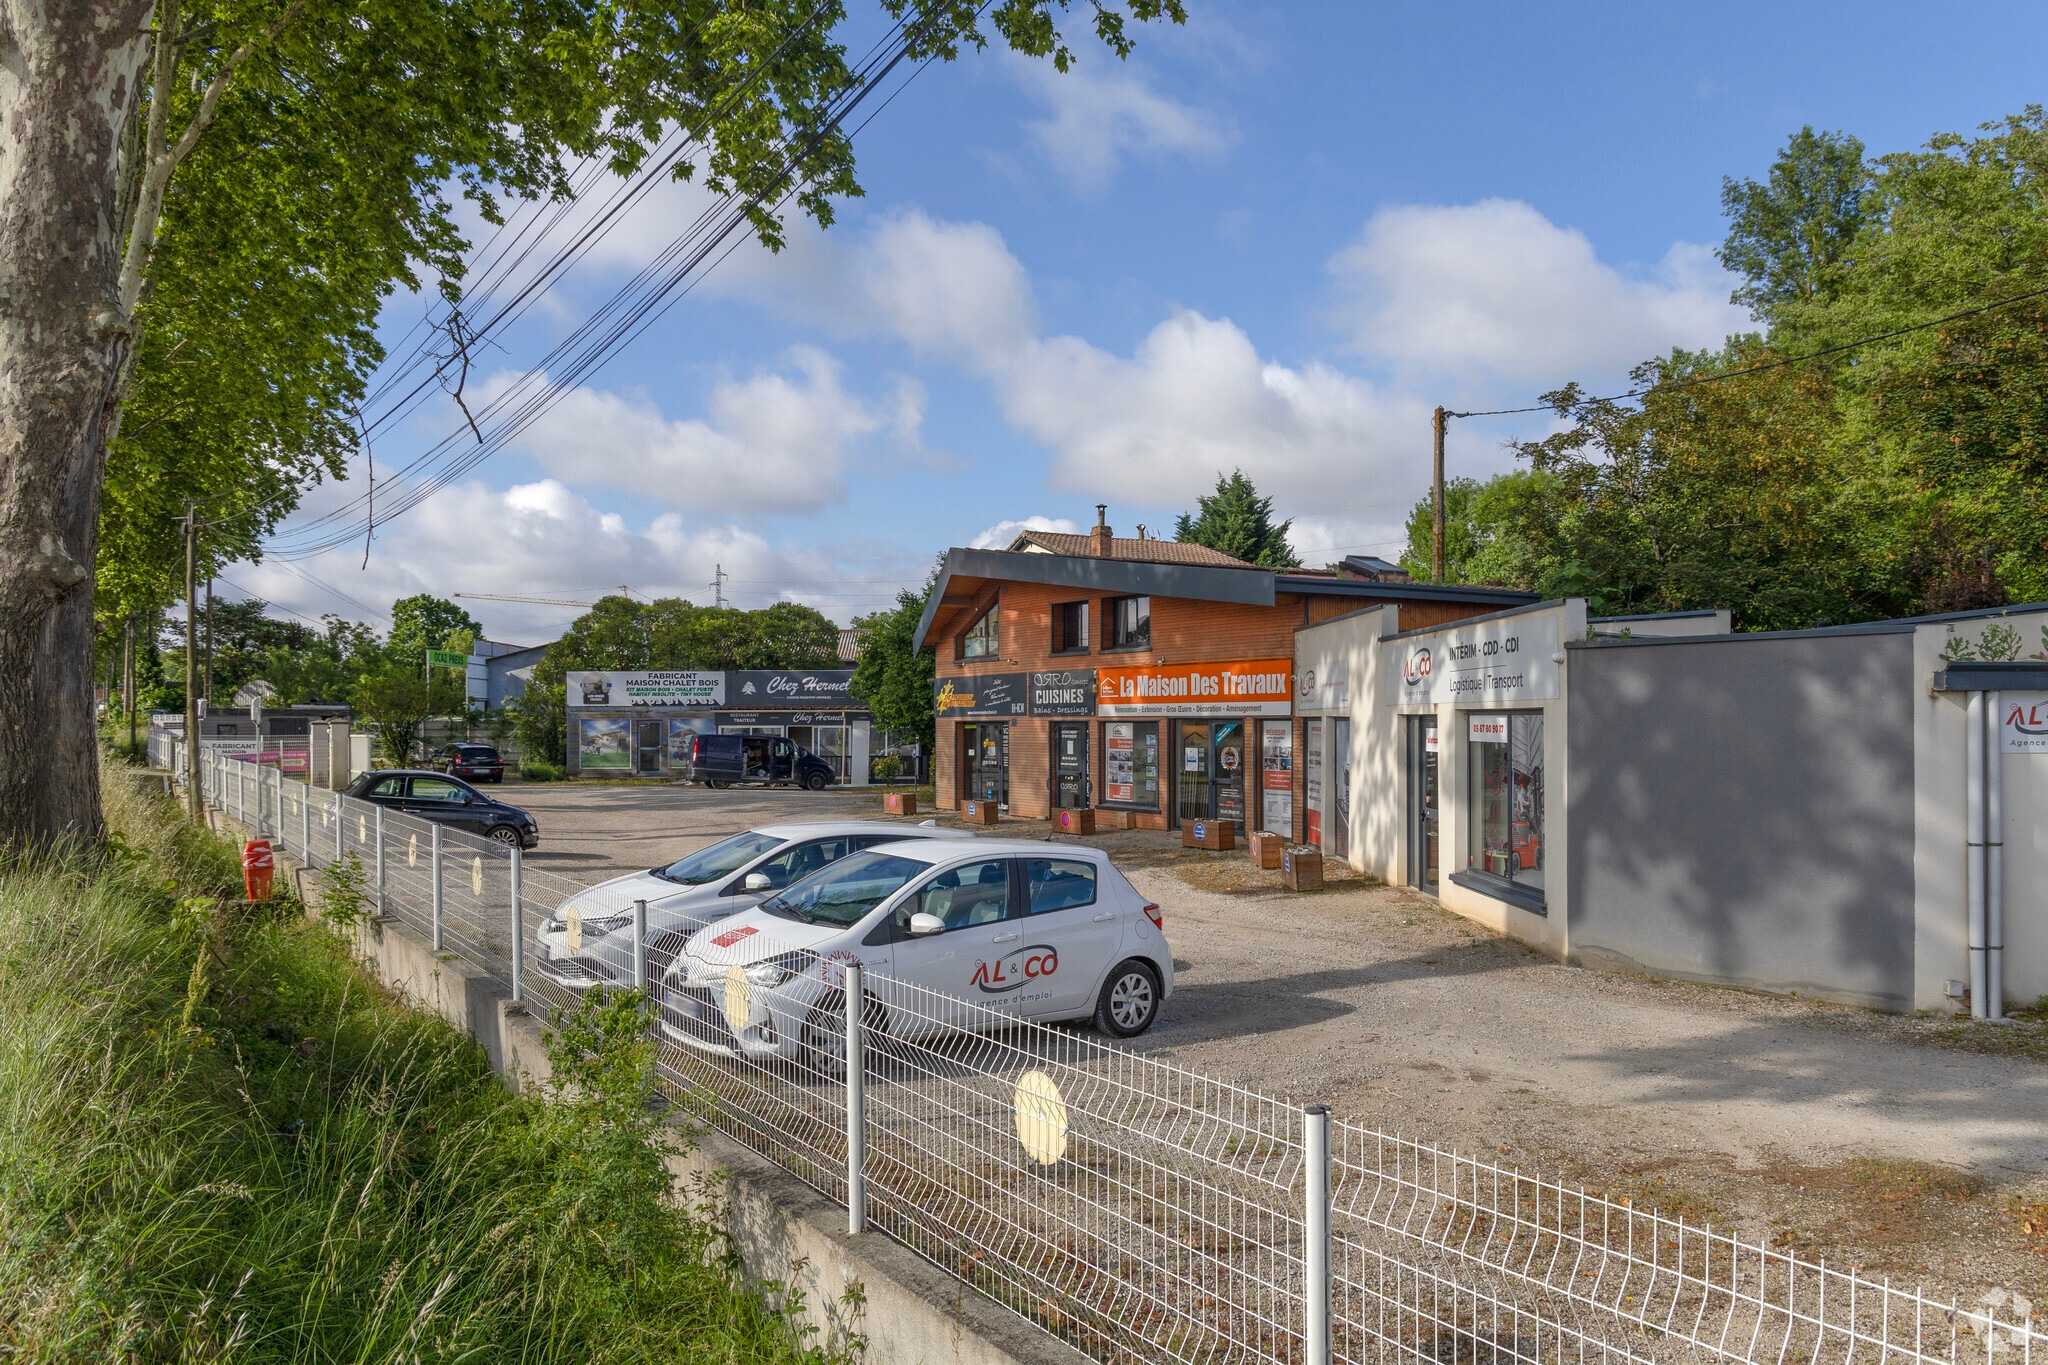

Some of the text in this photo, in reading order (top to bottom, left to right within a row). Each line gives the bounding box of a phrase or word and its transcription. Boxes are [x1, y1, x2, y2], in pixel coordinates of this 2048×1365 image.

[1449, 641, 1477, 661] INTÉRIM
[1482, 640, 1499, 657] CDD
[1505, 636, 1519, 654] CDI
[434, 652, 464, 665] OCAZ PNEUS
[1419, 656, 1432, 676] CO
[766, 676, 799, 695] Chez
[1120, 671, 1287, 697] La Maison Des Travaux
[1449, 676, 1482, 695] Logistique
[1487, 672, 1524, 693] Transport
[1035, 688, 1084, 705] CUISINES
[1033, 706, 1051, 714] Bains
[1057, 706, 1088, 715] Dressings
[1196, 705, 1223, 713] Décoration
[1226, 704, 1262, 713] Aménagement
[2006, 705, 2043, 726] AL
[792, 712, 813, 723] Chez
[1266, 728, 1286, 736] RÉUSSIR
[1473, 724, 1478, 733] 05
[2010, 739, 2046, 748] Agence
[969, 954, 1059, 986] AL & CO
[1012, 990, 1053, 1003] d'emploi
